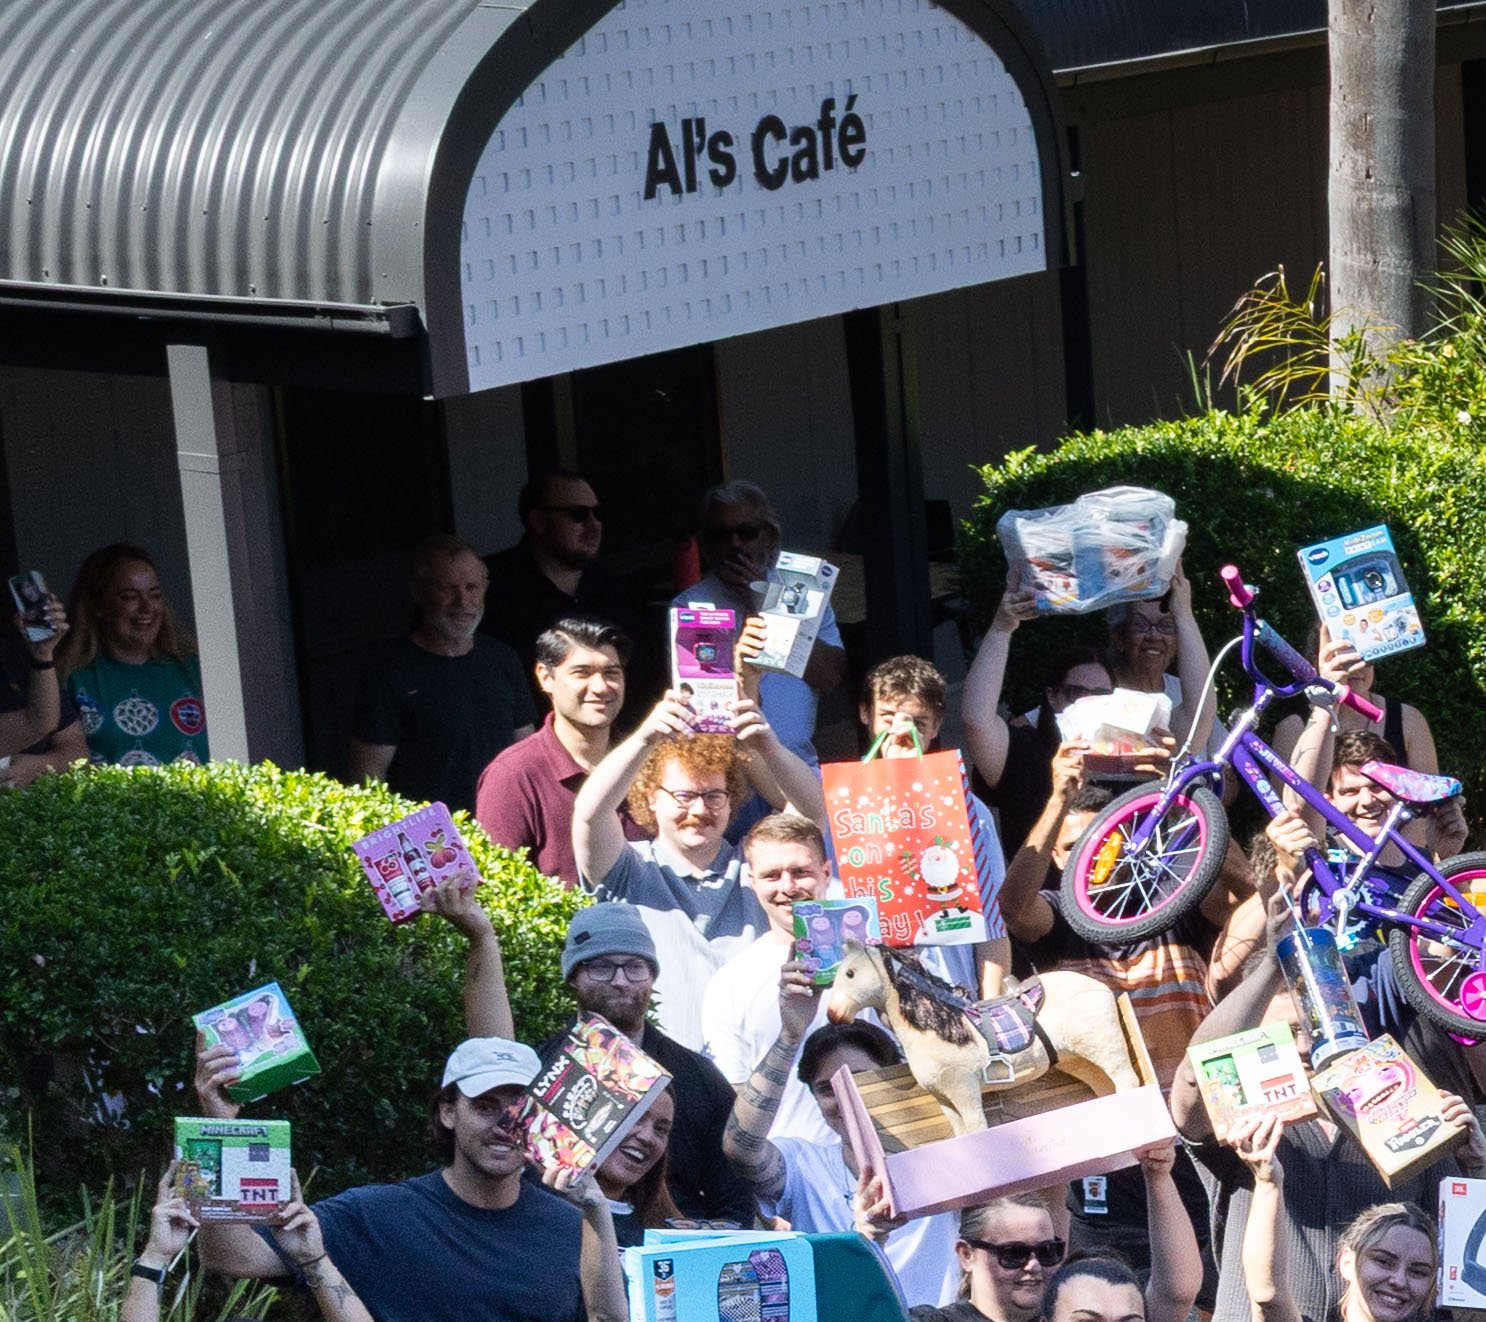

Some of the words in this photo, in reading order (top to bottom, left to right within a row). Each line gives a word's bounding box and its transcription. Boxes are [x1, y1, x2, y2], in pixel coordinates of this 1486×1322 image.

[643, 118, 737, 200] Al's
[751, 93, 867, 191] Café
[834, 802, 937, 838] Santa's
[849, 844, 883, 870] on
[849, 876, 895, 904] his
[533, 1055, 571, 1098] LYNX
[1263, 1083, 1299, 1102] TNT
[200, 1123, 269, 1138] MINECRAFT
[240, 1188, 280, 1203] TNT
